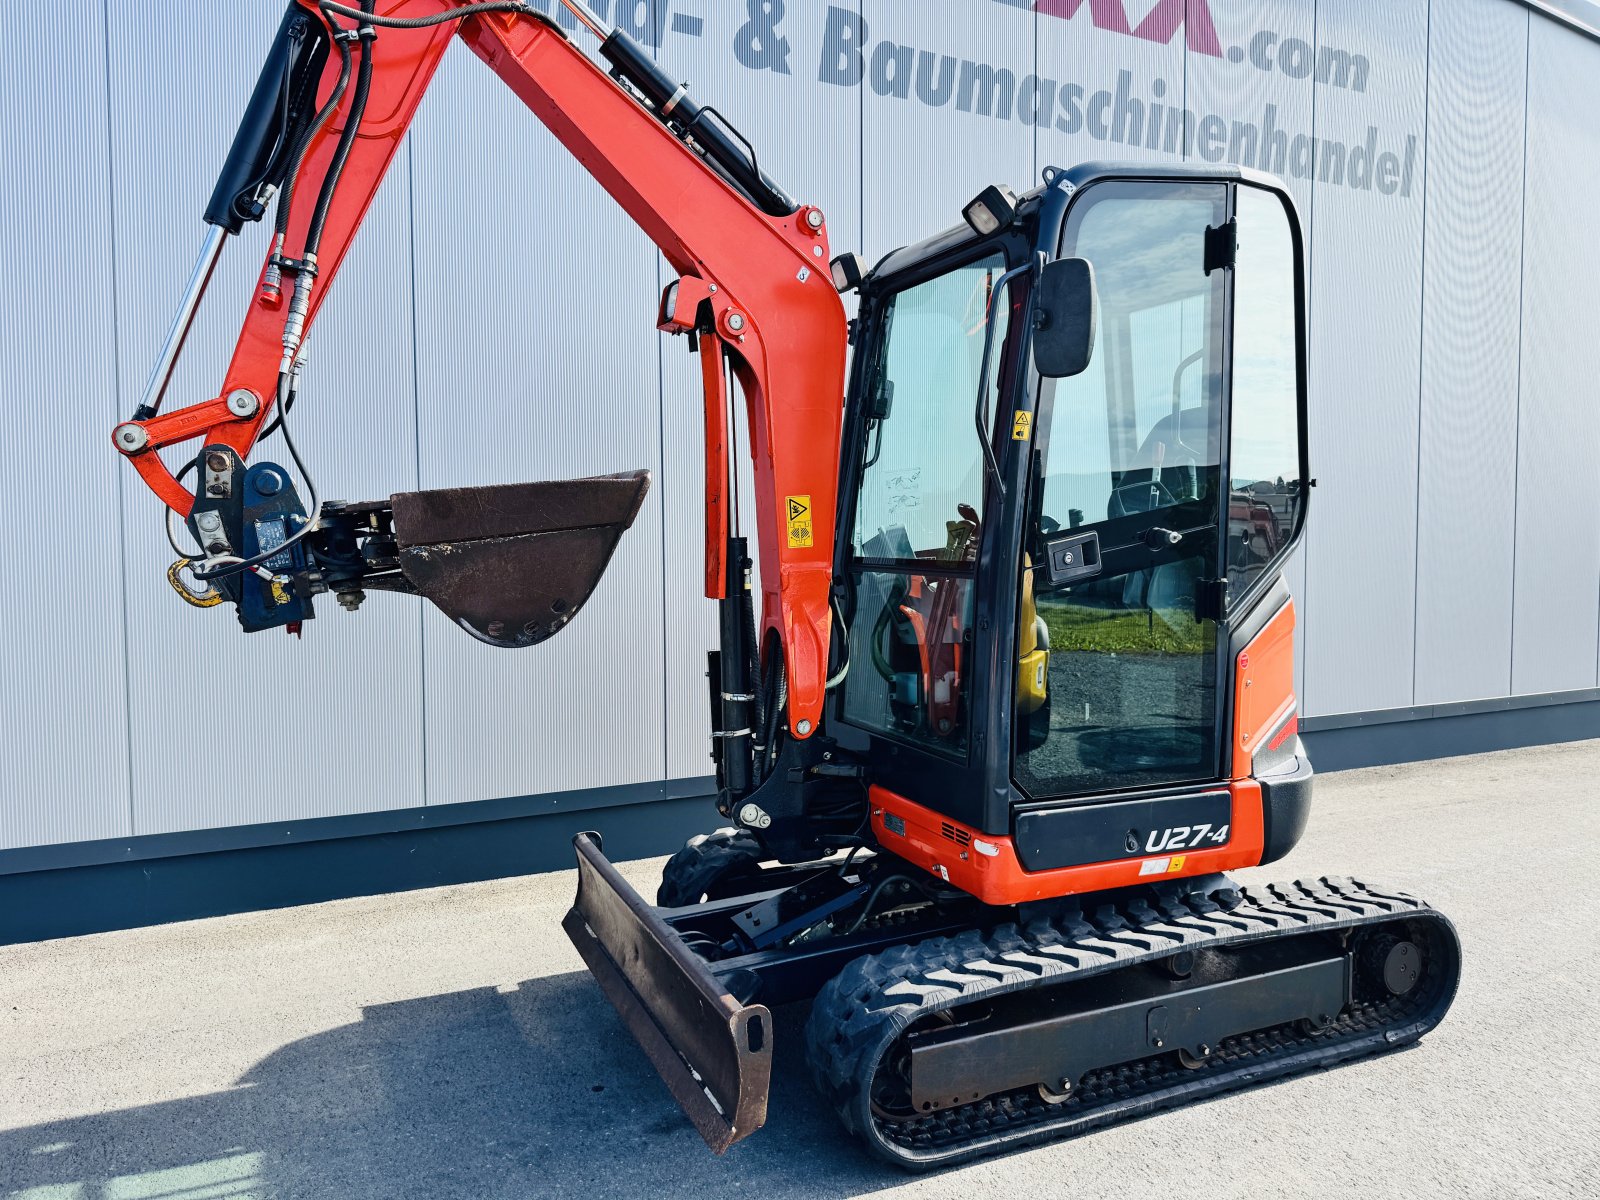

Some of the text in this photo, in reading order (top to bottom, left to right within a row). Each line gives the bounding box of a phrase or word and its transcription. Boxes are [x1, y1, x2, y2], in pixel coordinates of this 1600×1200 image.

[733, 0, 792, 76] &
[818, 5, 1417, 198] Baumaschinenhandel
[1145, 823, 1230, 853] U27-4
